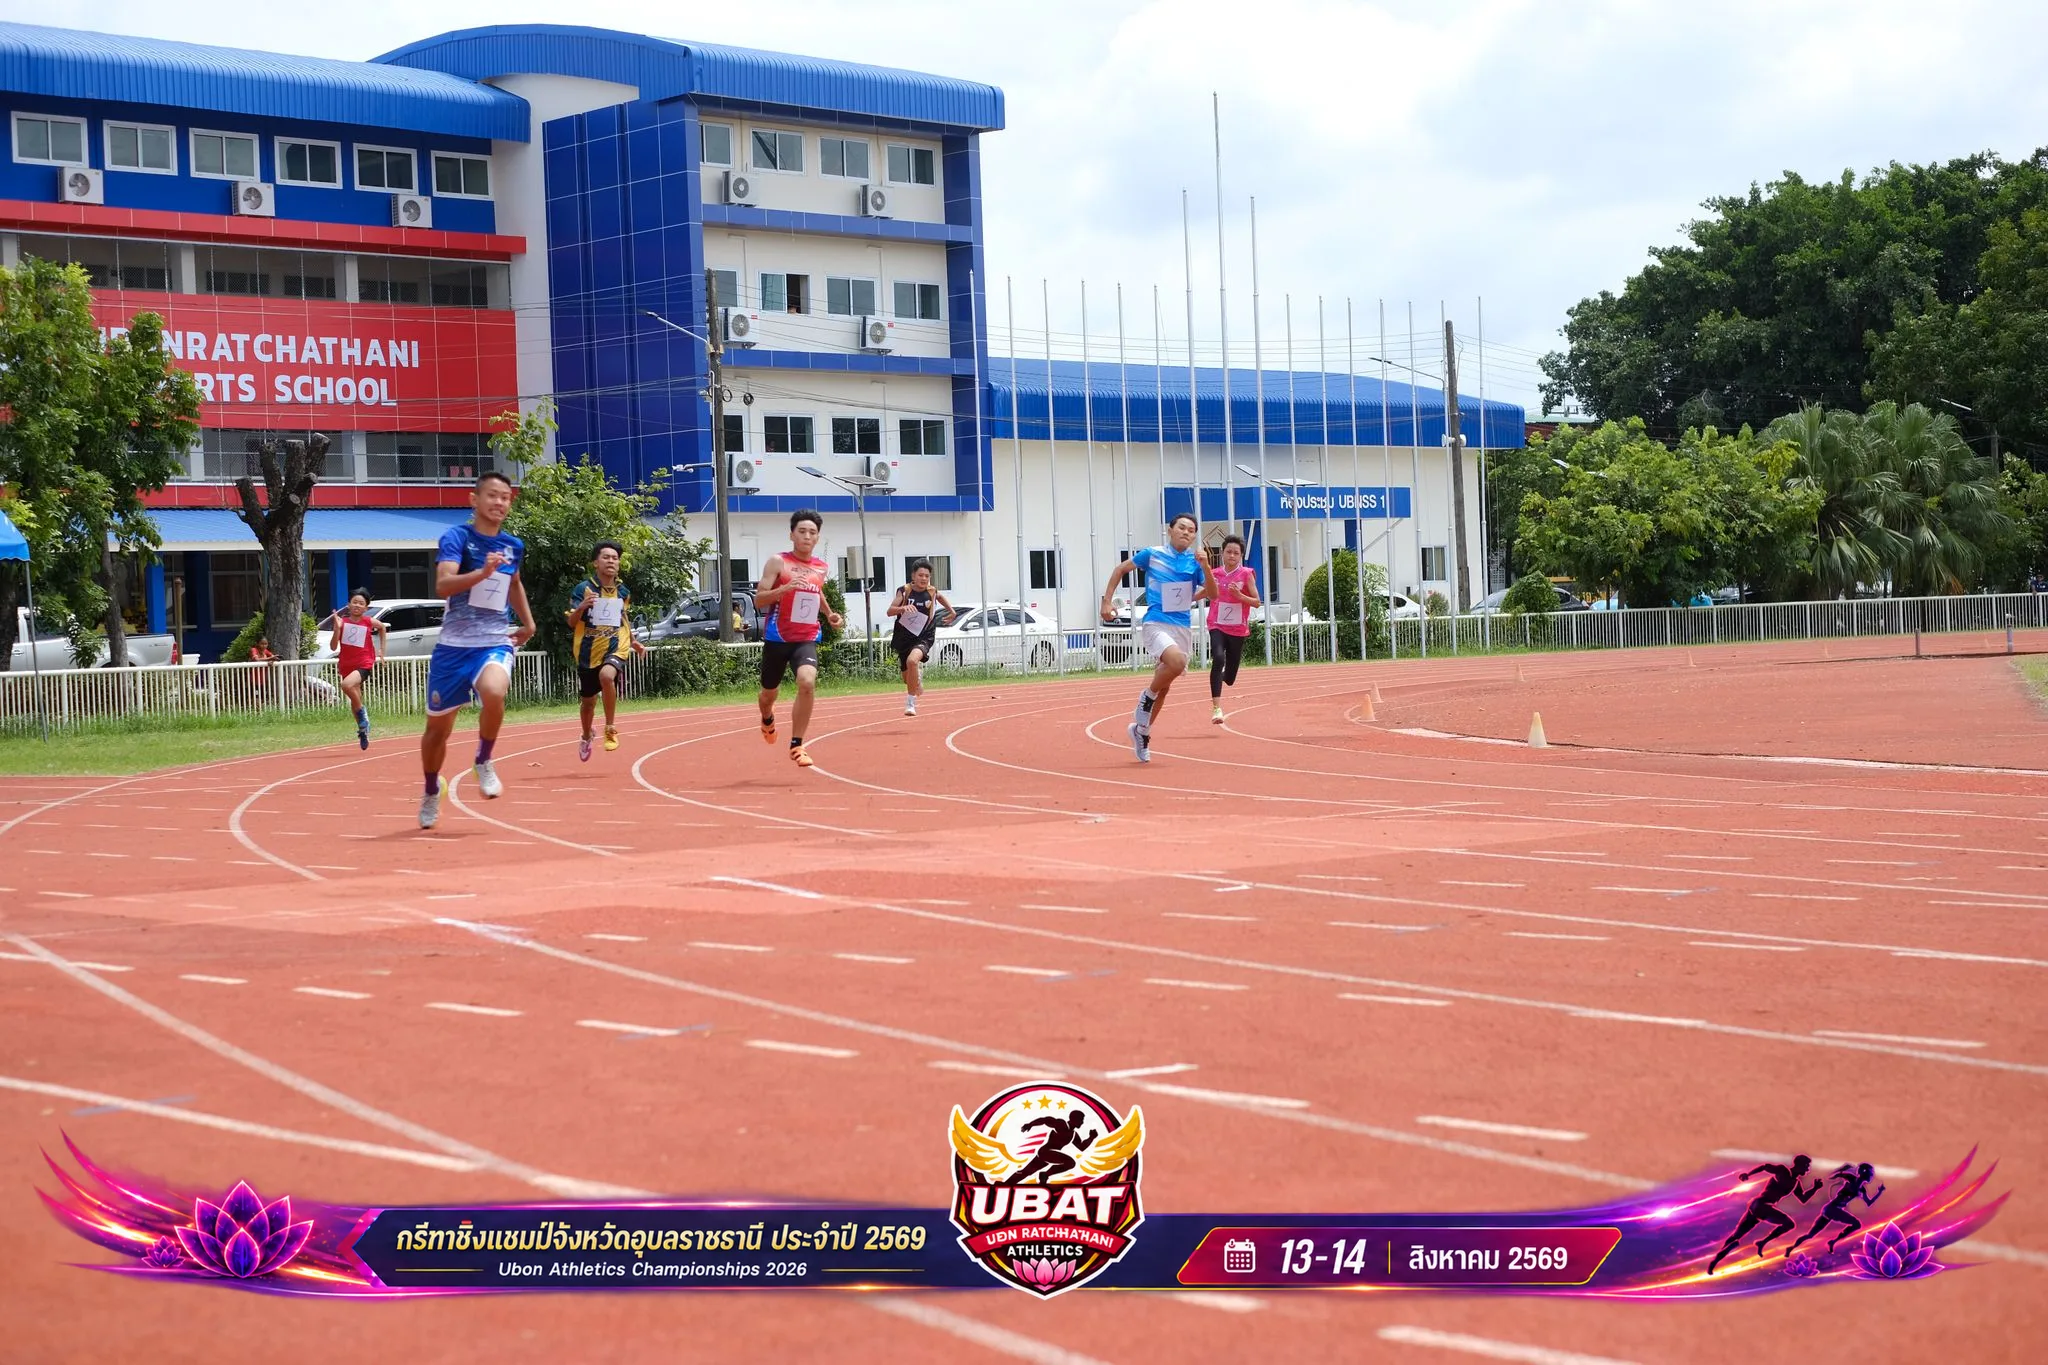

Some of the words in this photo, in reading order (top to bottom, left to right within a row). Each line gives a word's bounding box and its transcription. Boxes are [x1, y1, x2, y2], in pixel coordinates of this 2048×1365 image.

[274, 375, 398, 407] SCHOOL
[1380, 494, 1386, 509] 1
[484, 578, 502, 601] 7
[1171, 587, 1183, 606] 3
[602, 602, 611, 617] 6
[799, 598, 813, 619] 5
[1223, 606, 1235, 621] 2
